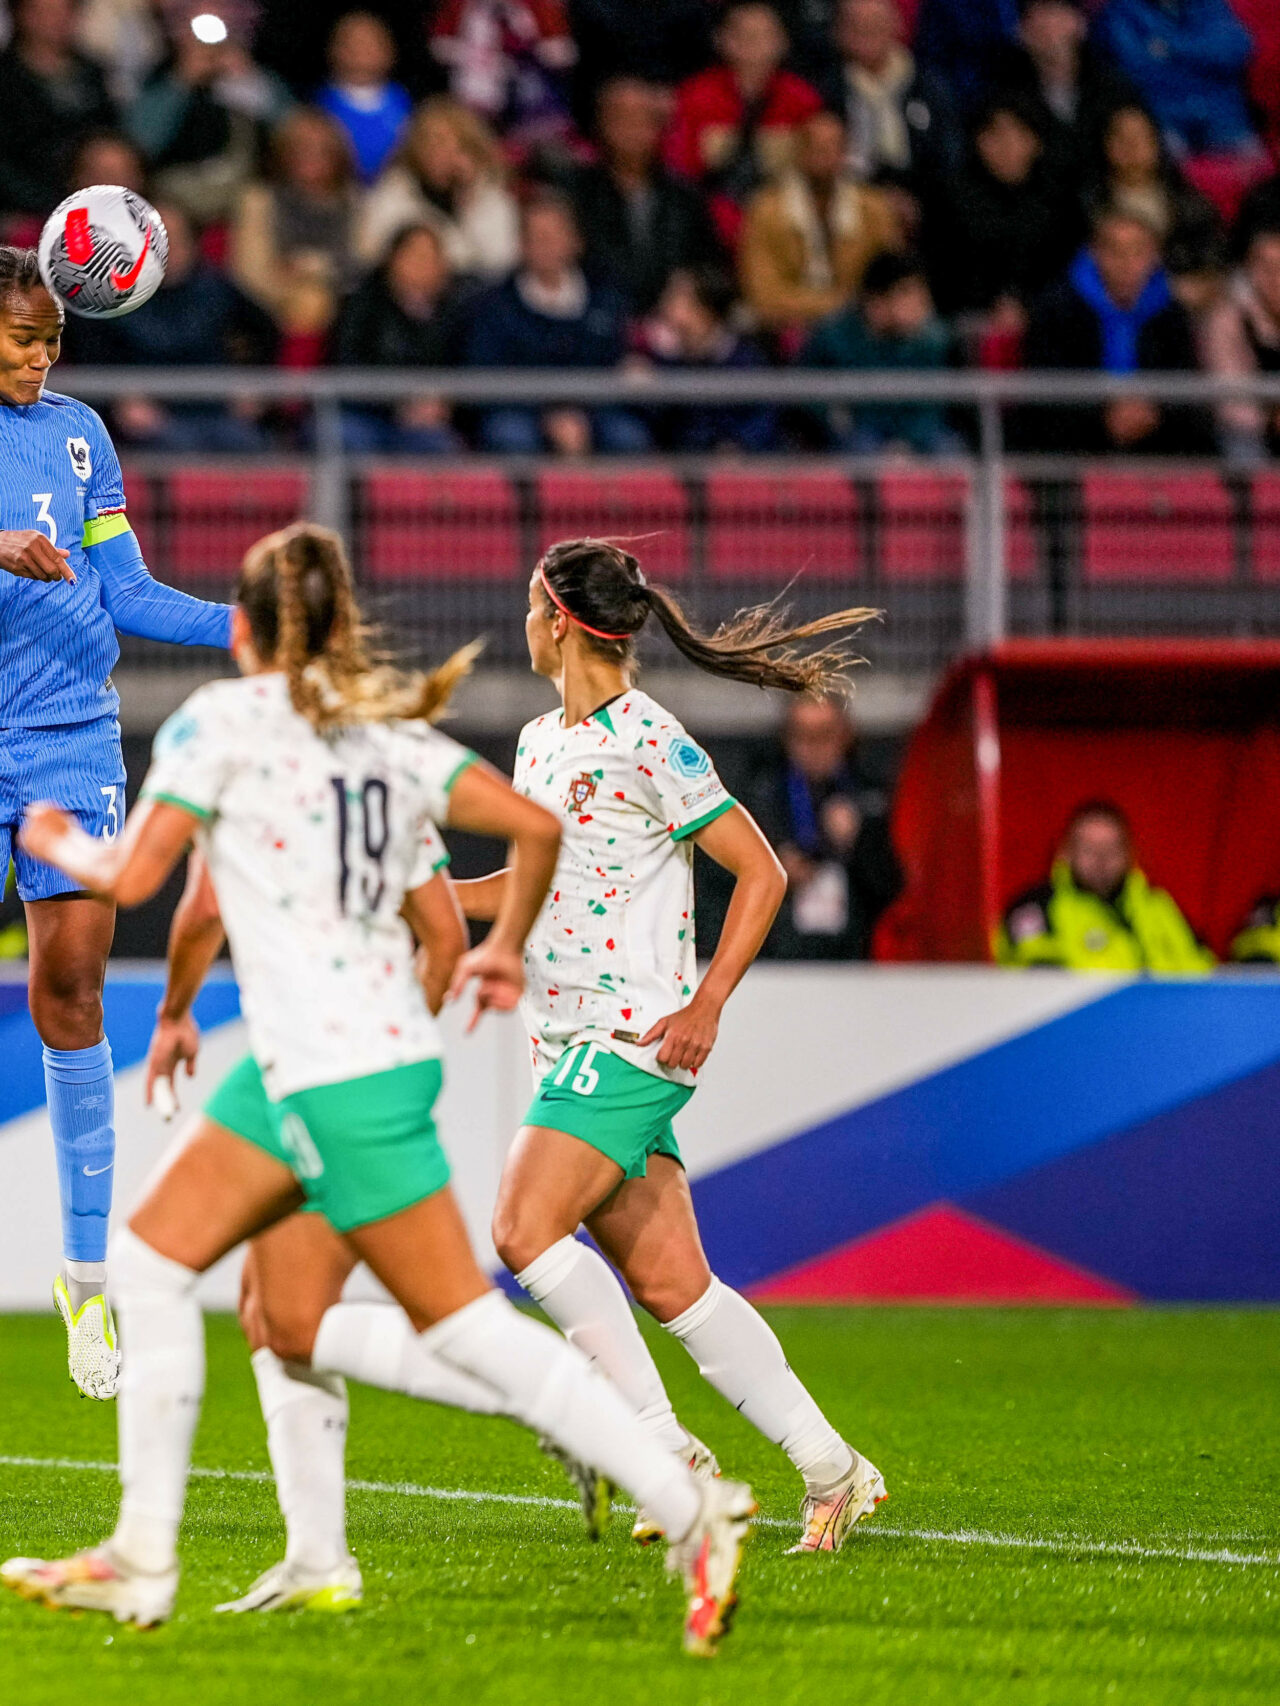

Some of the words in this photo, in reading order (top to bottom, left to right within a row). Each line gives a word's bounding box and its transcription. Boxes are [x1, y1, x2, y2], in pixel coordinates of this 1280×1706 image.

[32, 493, 57, 546] 3
[100, 785, 118, 845] 3
[331, 777, 390, 918] 19
[553, 1041, 611, 1096] 15
